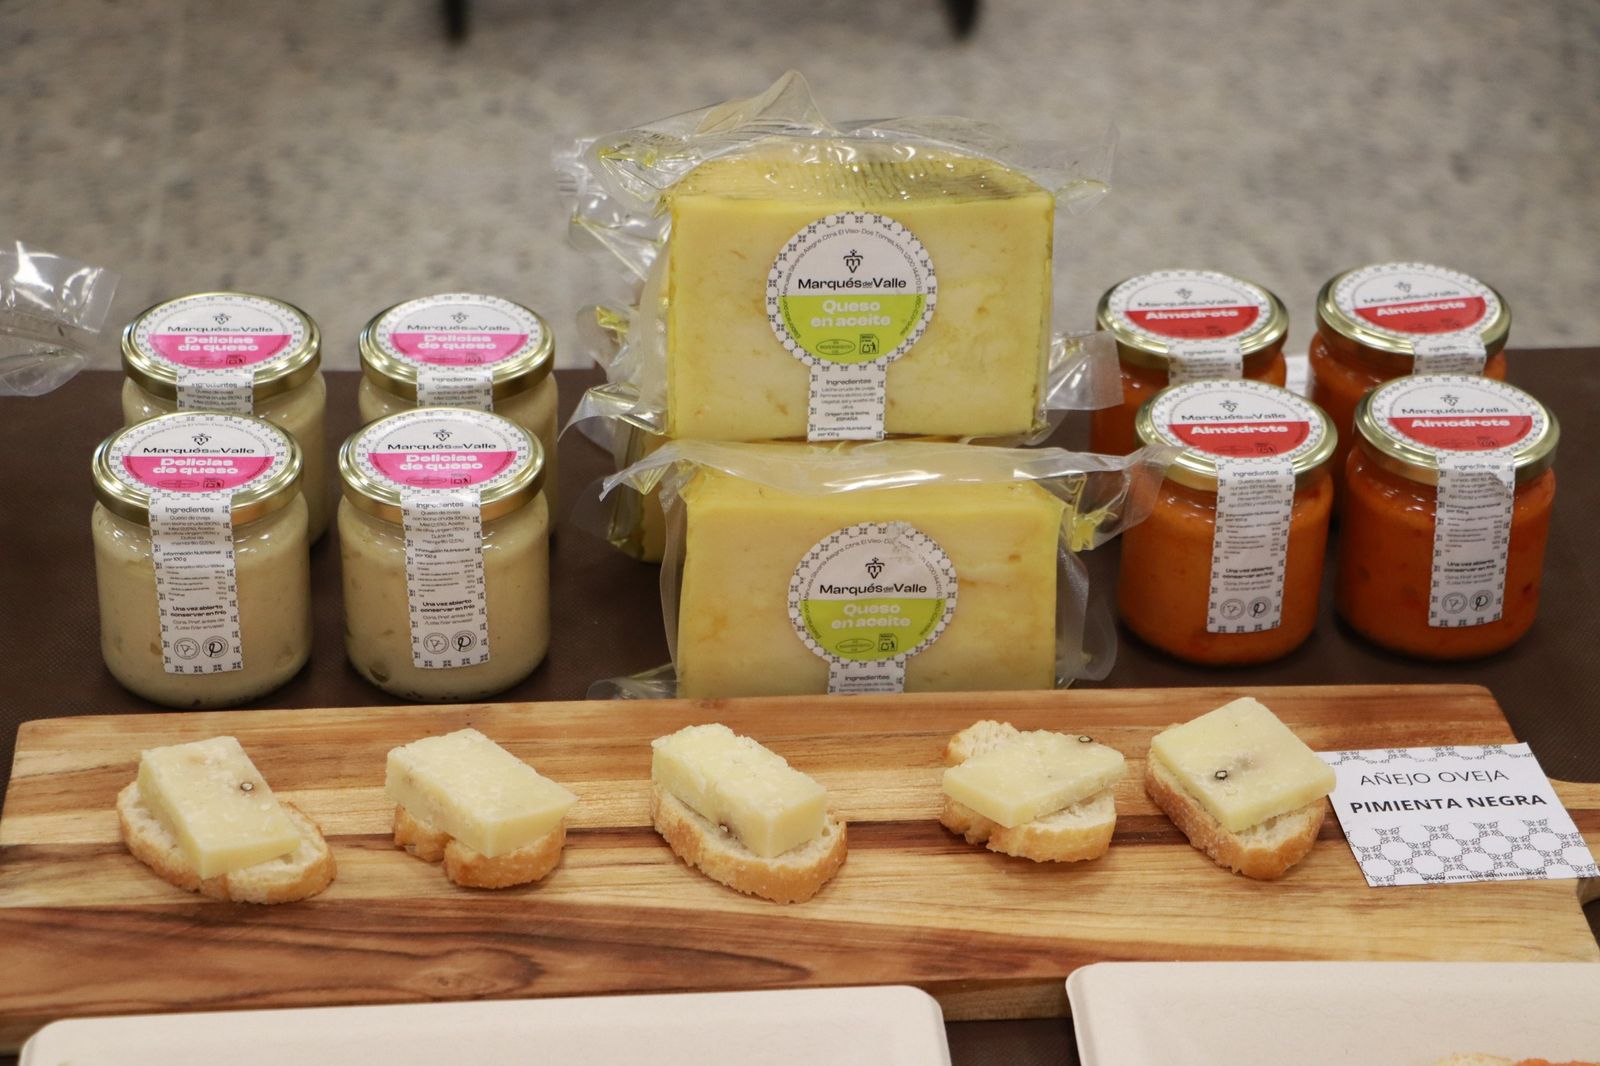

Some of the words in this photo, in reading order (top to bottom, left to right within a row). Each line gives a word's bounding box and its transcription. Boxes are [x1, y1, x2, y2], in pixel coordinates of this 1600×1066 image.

[798, 277, 862, 291] Marqués
[872, 277, 907, 288] Valle
[822, 300, 880, 314] Queso
[1376, 302, 1467, 317] Almodrote
[1145, 310, 1239, 320] Almodrote
[810, 317, 832, 328] en
[835, 315, 891, 327] aceite
[184, 336, 254, 344] Delicias
[423, 335, 492, 343] Delicias
[204, 344, 259, 353] queso
[417, 342, 441, 350] de
[442, 343, 496, 351] queso
[826, 378, 871, 386] Ingredientes
[1411, 418, 1511, 428] Almodrote
[1191, 425, 1288, 435] Almodrote
[143, 446, 210, 456] Marqués
[387, 442, 453, 452] Marqués
[160, 458, 233, 467] Delicias
[406, 454, 477, 462] Delicias
[153, 466, 177, 474] de
[179, 467, 239, 476] queso
[399, 462, 422, 470] de
[425, 463, 483, 472] queso
[165, 506, 214, 514] Ingredientes
[819, 583, 883, 596] Marqués
[893, 583, 927, 593] Valle
[843, 603, 900, 616] Queso
[831, 619, 853, 630] en
[855, 616, 911, 628] aceite
[1360, 771, 1431, 786] AÑEJO
[1438, 769, 1510, 784] OVEJA
[1350, 798, 1463, 814] PIMIENTA
[1466, 794, 1547, 808] NEGRA
